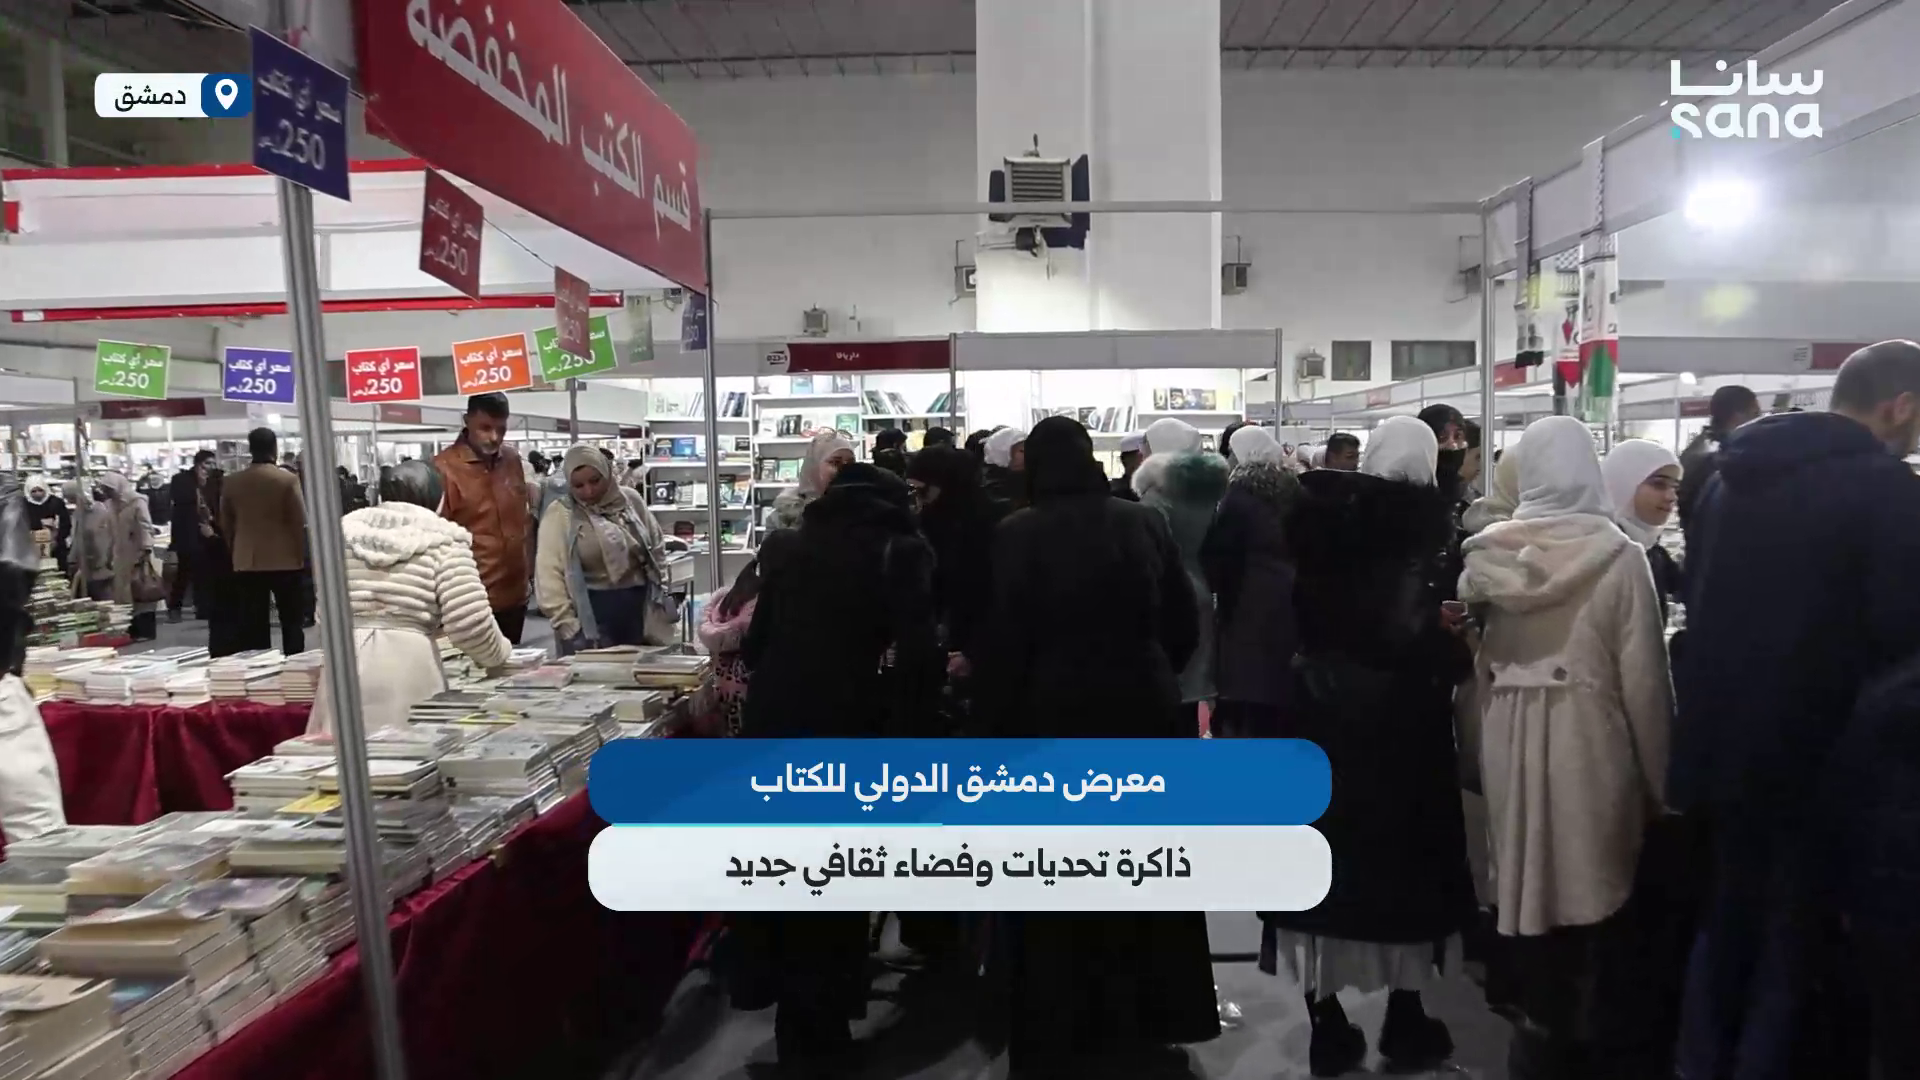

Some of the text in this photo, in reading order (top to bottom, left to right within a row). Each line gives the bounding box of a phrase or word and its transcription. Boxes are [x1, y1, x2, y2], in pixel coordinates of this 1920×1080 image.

[279, 118, 326, 171] 250
[581, 112, 645, 199] الكتب
[653, 161, 692, 241] قسم
[440, 235, 468, 276] 250
[115, 371, 150, 389] 250
[242, 377, 277, 395] 250
[367, 377, 403, 395] 250
[476, 366, 511, 385] 250
